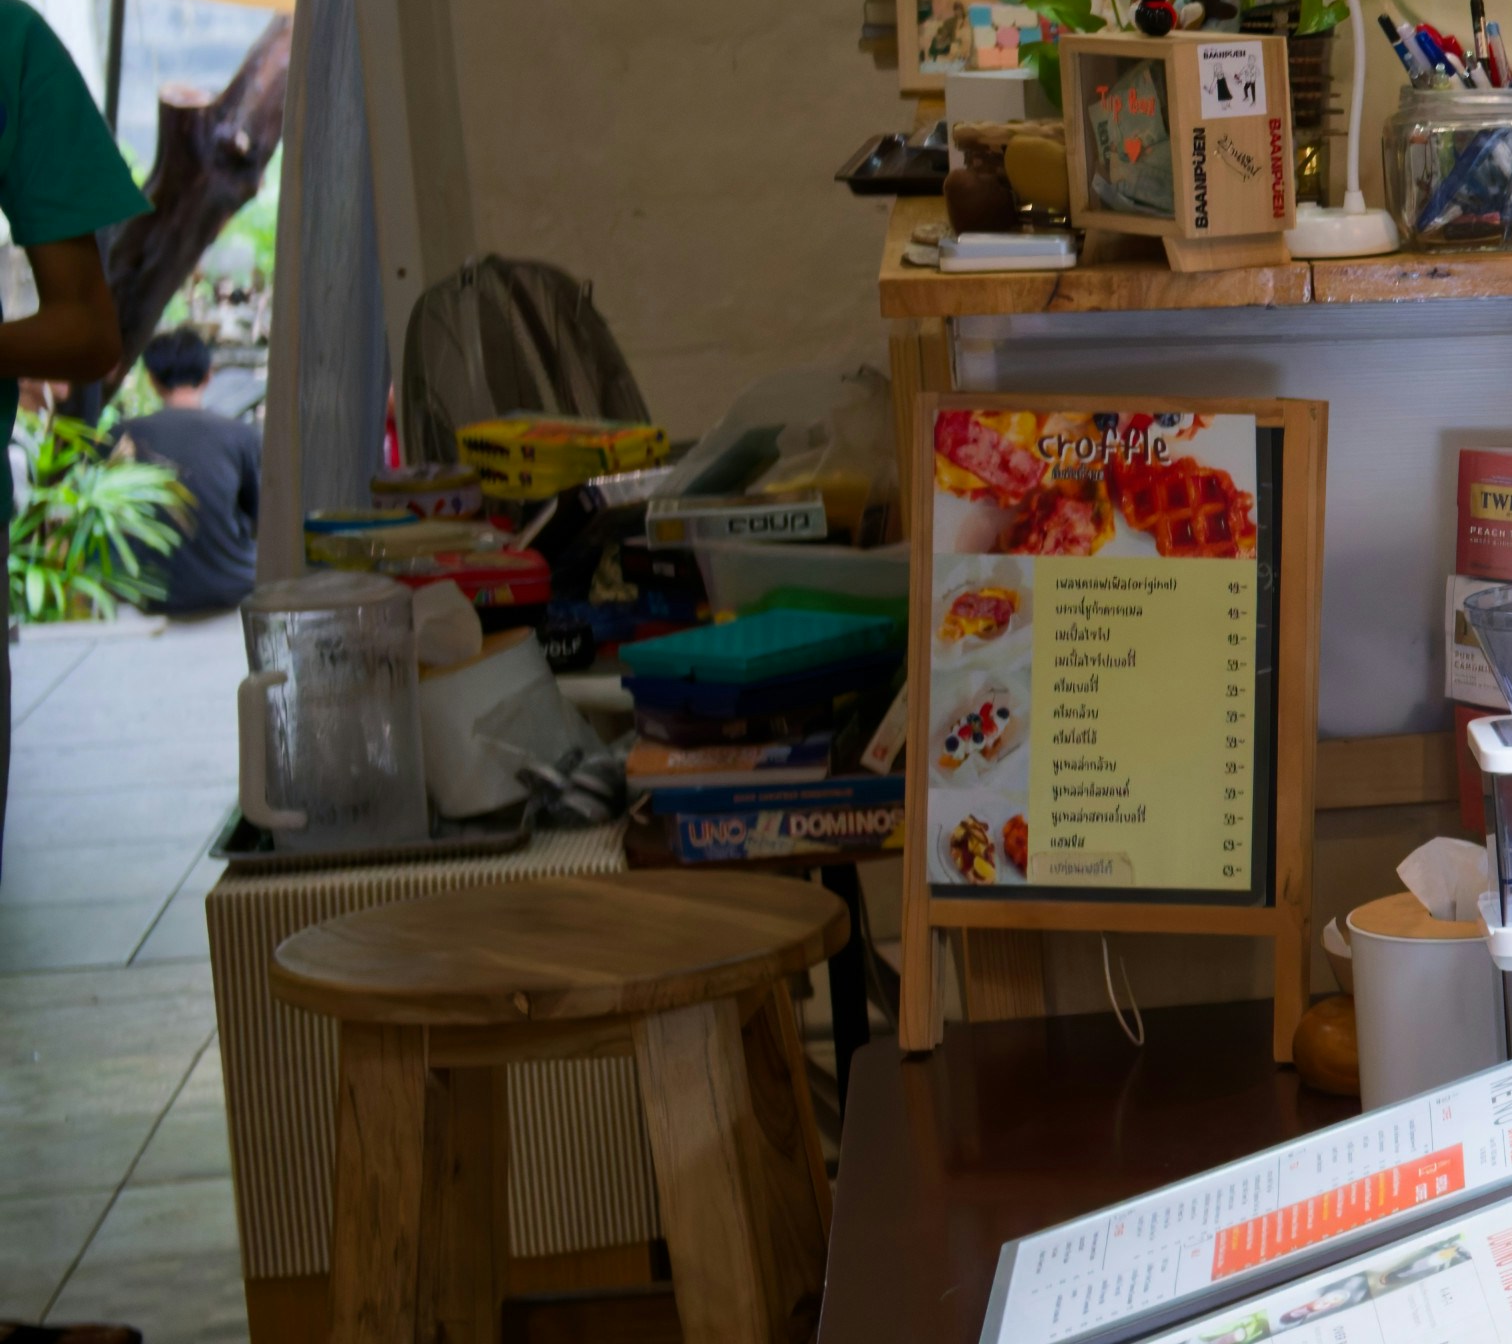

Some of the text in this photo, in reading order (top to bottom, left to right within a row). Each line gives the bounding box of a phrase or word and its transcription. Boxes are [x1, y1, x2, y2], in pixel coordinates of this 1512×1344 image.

[1193, 127, 1209, 229] BAANPÜEN
[1269, 118, 1285, 219] BAANPÜEN
[1037, 424, 1169, 464] croffle
[1470, 526, 1506, 537] PEACH
[688, 819, 747, 849] UNO
[1330, 1324, 1346, 1343] OVER
